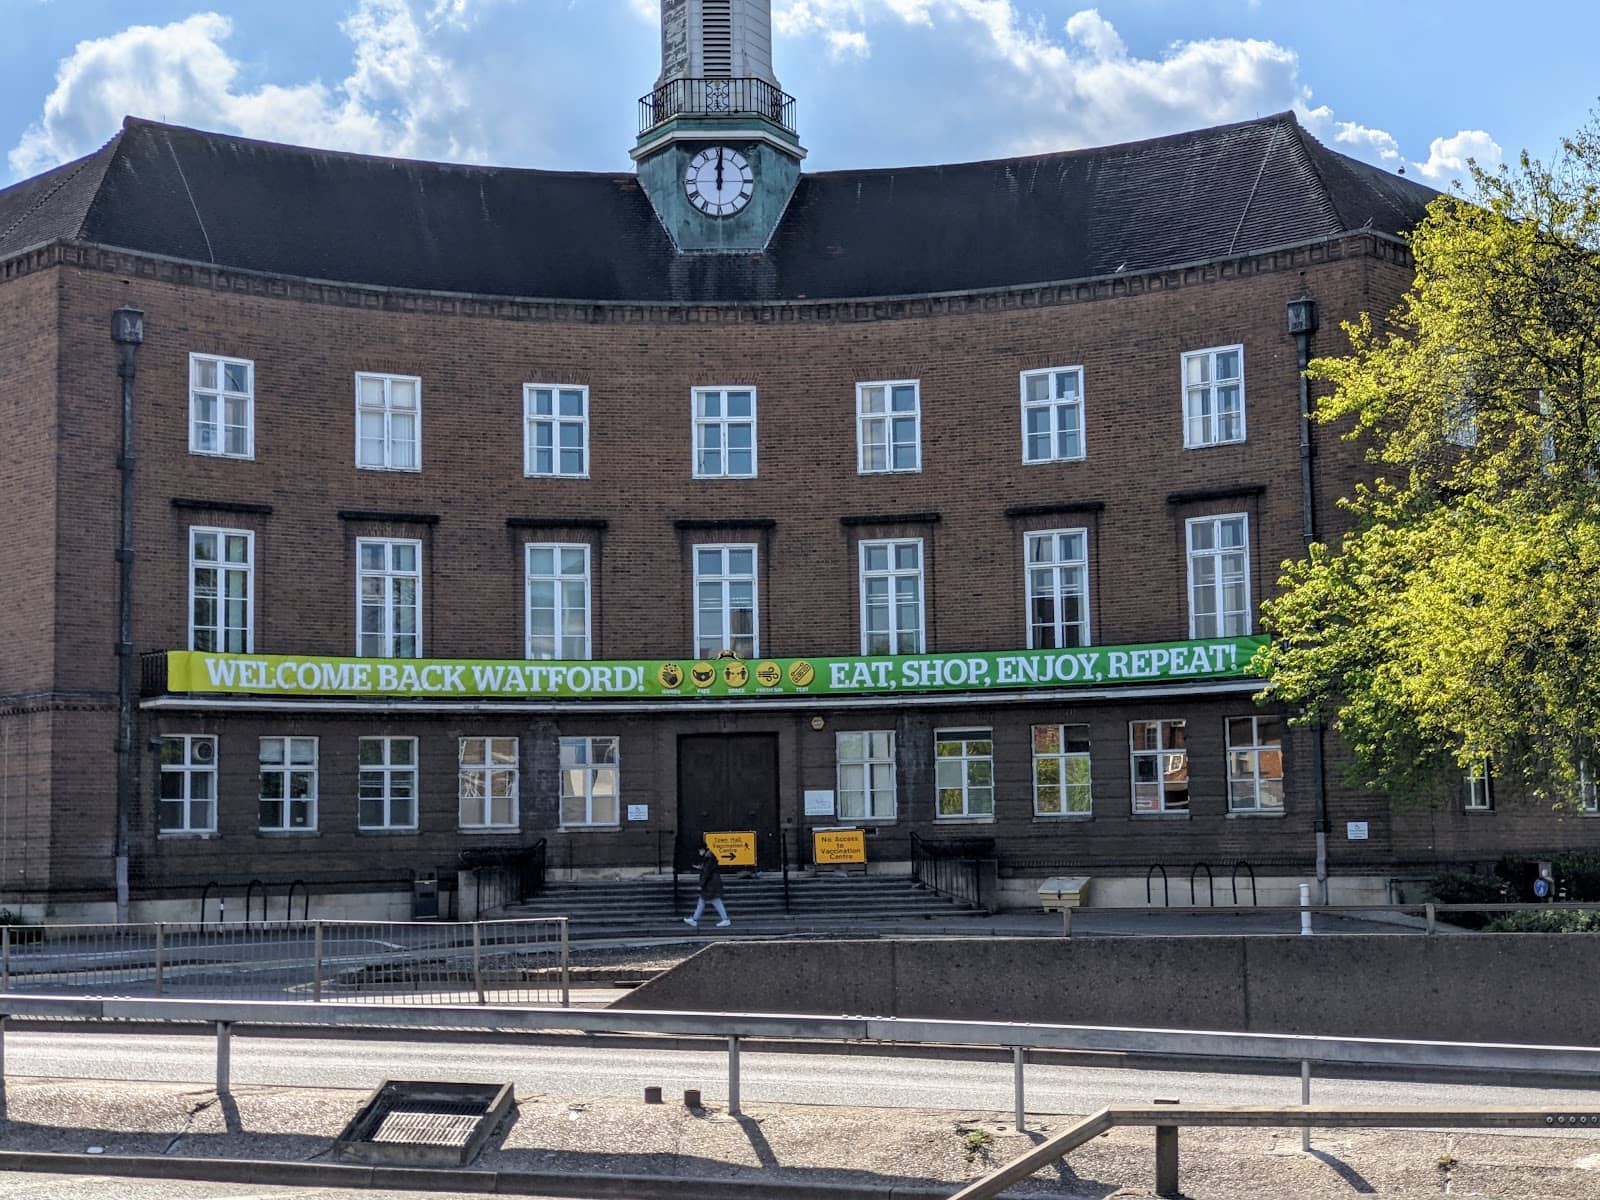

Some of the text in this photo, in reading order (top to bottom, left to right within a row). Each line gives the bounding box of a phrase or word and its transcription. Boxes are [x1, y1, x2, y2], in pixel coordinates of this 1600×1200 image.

[205, 658, 645, 693] WELCOME BACK WATFORD!
[829, 644, 1237, 689] EAT, SHOP, ENJOY, REPEAT!
